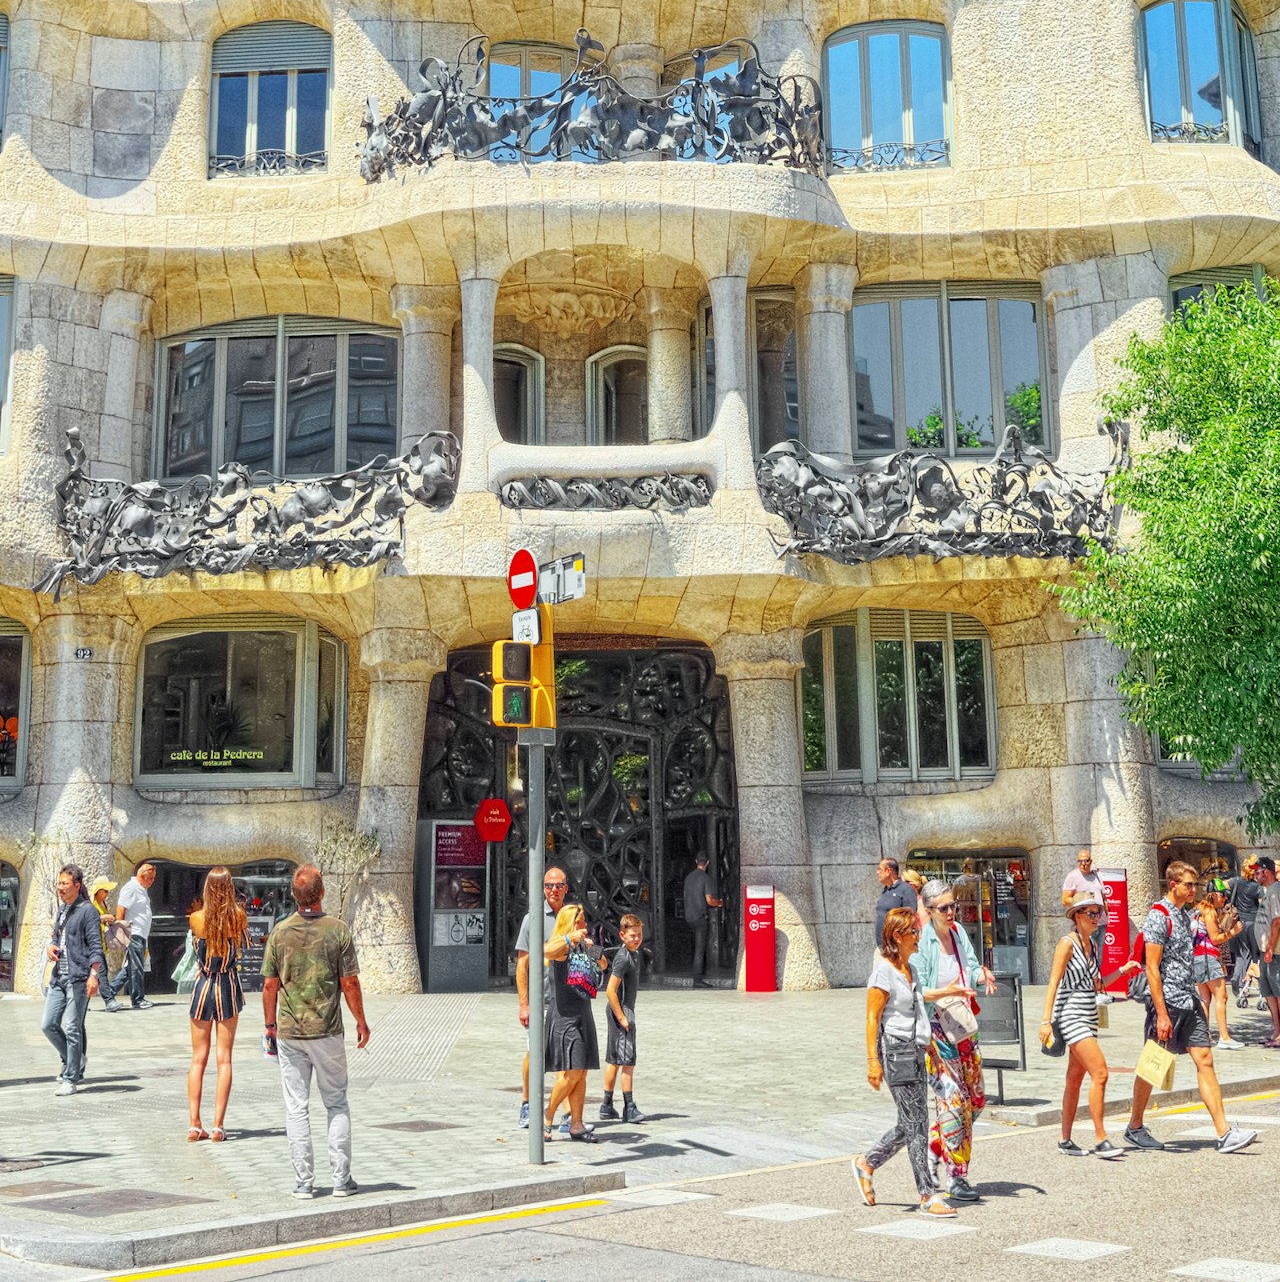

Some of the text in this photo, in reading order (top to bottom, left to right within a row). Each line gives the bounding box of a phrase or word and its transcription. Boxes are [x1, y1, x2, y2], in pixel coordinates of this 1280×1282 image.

[77, 648, 91, 659] 92
[195, 751, 208, 760] de
[210, 750, 221, 760] la
[223, 750, 264, 760] Pedrera
